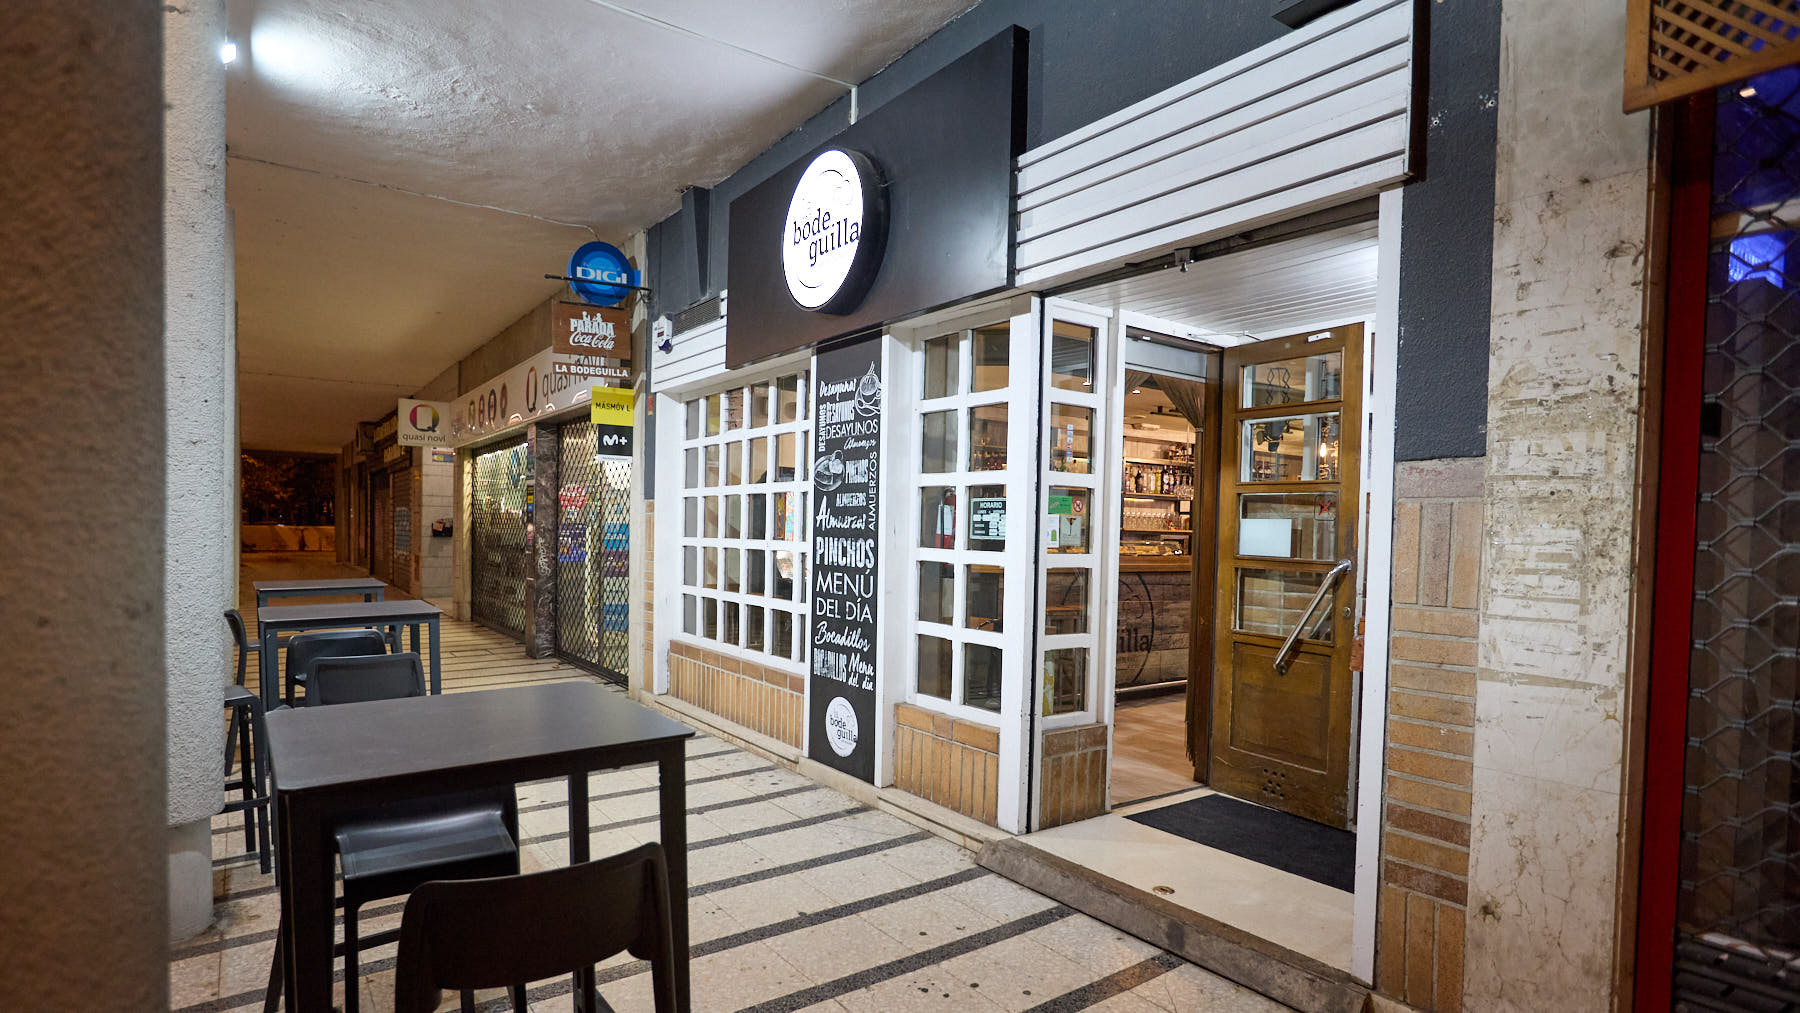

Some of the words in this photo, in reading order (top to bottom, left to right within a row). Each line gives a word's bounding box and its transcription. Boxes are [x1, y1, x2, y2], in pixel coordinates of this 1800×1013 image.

[793, 208, 831, 246] bode
[809, 218, 860, 267] guilla
[576, 266, 627, 284] DIGI
[570, 318, 616, 338] PARADA
[555, 364, 568, 373] LA
[570, 365, 628, 377] BODEGUILLA
[428, 434, 446, 442] novi
[818, 404, 826, 452] DESAYUNOS
[826, 419, 878, 439] DESAYUNOS
[869, 451, 877, 531] ALMUERZOS
[816, 537, 875, 568] PINCHOS
[816, 569, 874, 599] MENÚ
[816, 597, 841, 618] DEL
[846, 598, 873, 624] DÍA
[815, 621, 871, 652] Bocadillos
[848, 672, 859, 688] del
[830, 717, 847, 729] bode
[837, 729, 857, 743] guilla
